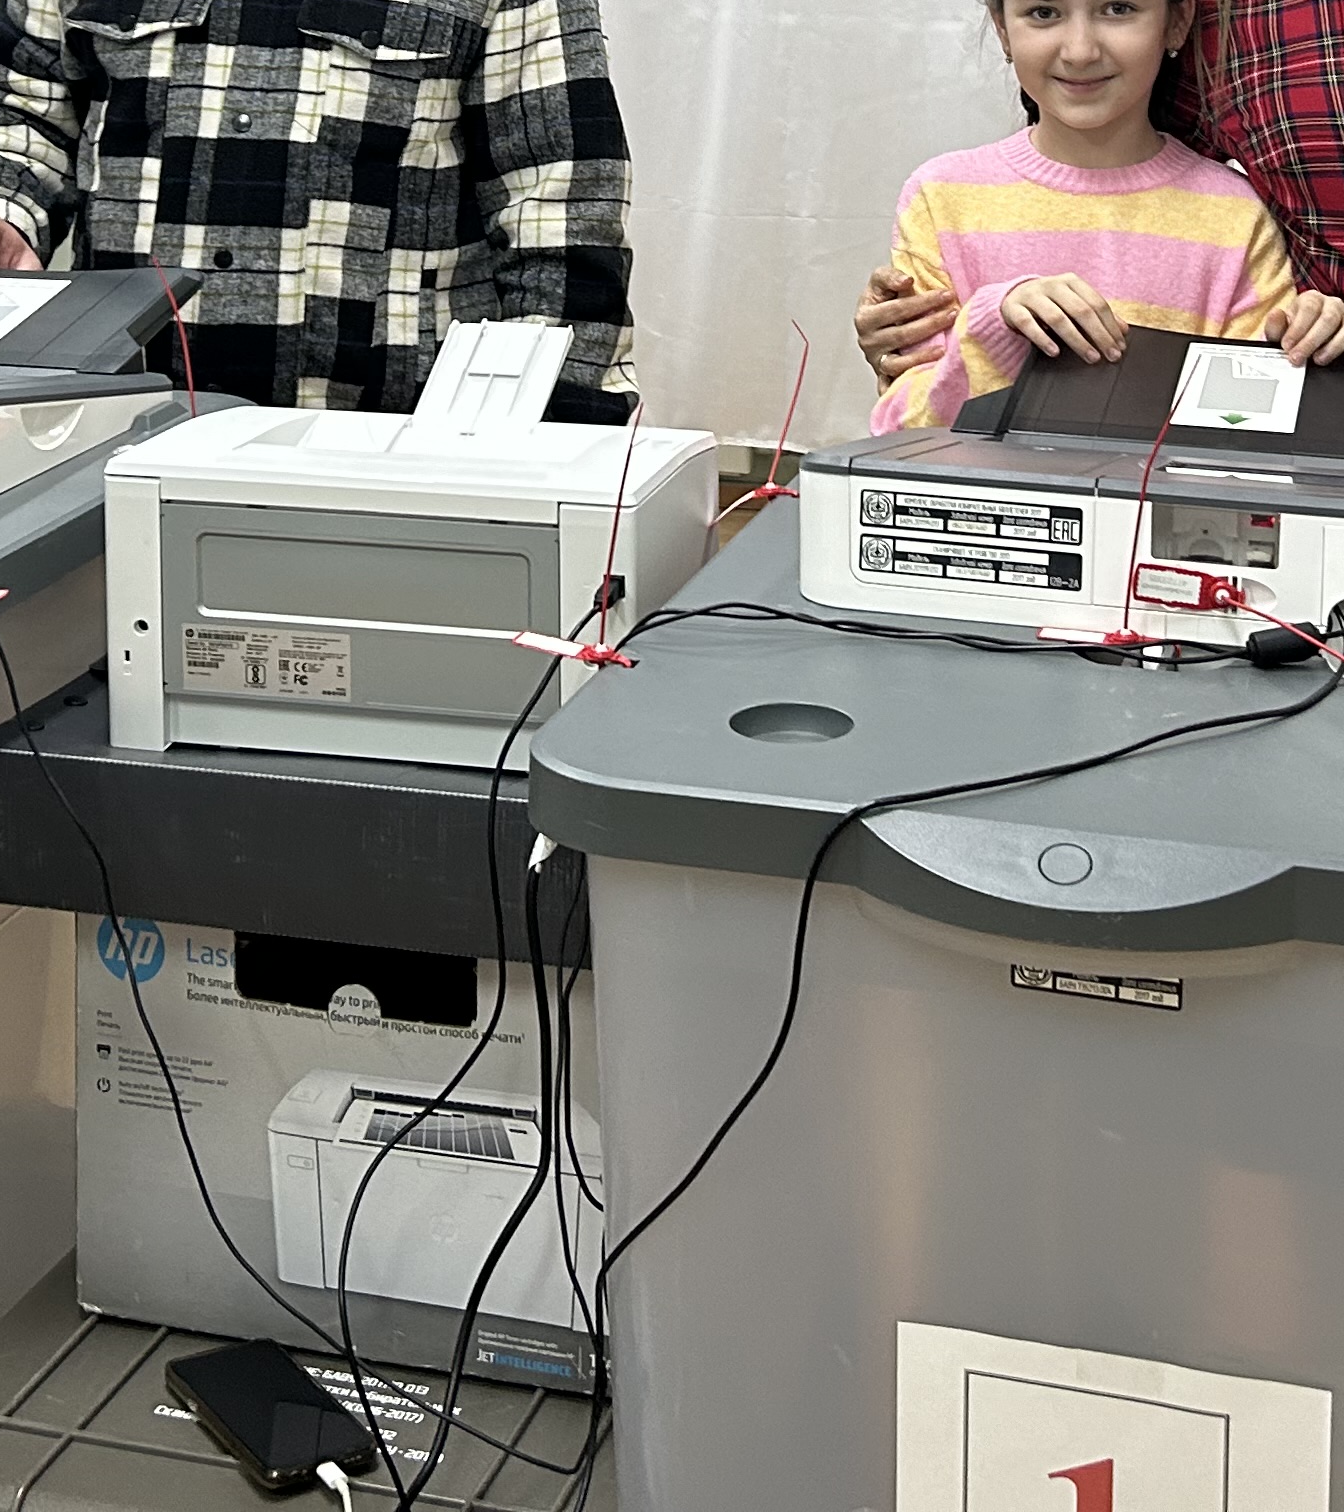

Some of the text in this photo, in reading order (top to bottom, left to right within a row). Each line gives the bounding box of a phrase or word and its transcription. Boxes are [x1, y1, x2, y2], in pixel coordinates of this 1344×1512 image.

[1053, 519, 1078, 542] EAC
[187, 972, 206, 986] The
[207, 977, 234, 990] smar
[348, 996, 360, 1007] to
[186, 989, 219, 1004] Более
[330, 1010, 380, 1028] быстрый
[382, 1020, 389, 1029] и
[439, 1028, 478, 1040] способ
